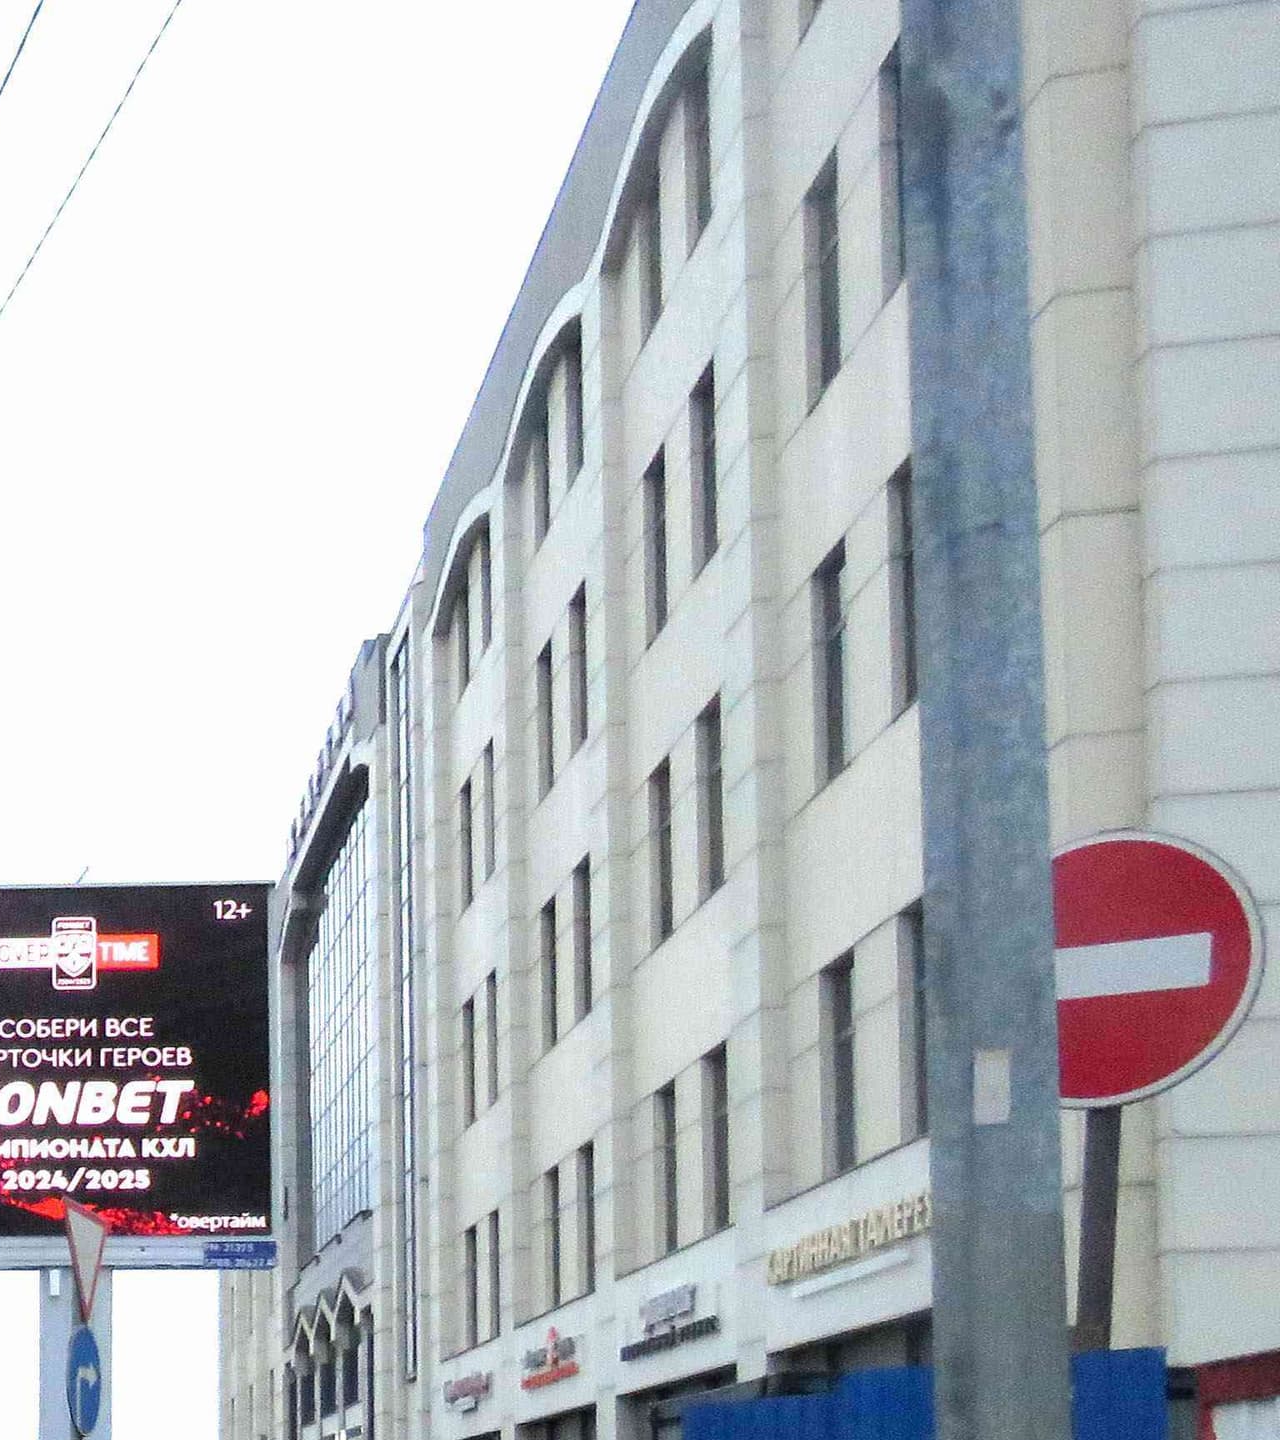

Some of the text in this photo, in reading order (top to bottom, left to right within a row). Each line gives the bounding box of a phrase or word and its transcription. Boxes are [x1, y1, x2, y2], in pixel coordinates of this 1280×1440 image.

[213, 900, 252, 920] 12+
[98, 941, 150, 962] TIME
[105, 1017, 154, 1038] ВСЕ
[99, 1047, 192, 1067] ГЕРОЕВ
[141, 1137, 196, 1159] КХЛ
[1, 1166, 152, 1192] 2024/2025
